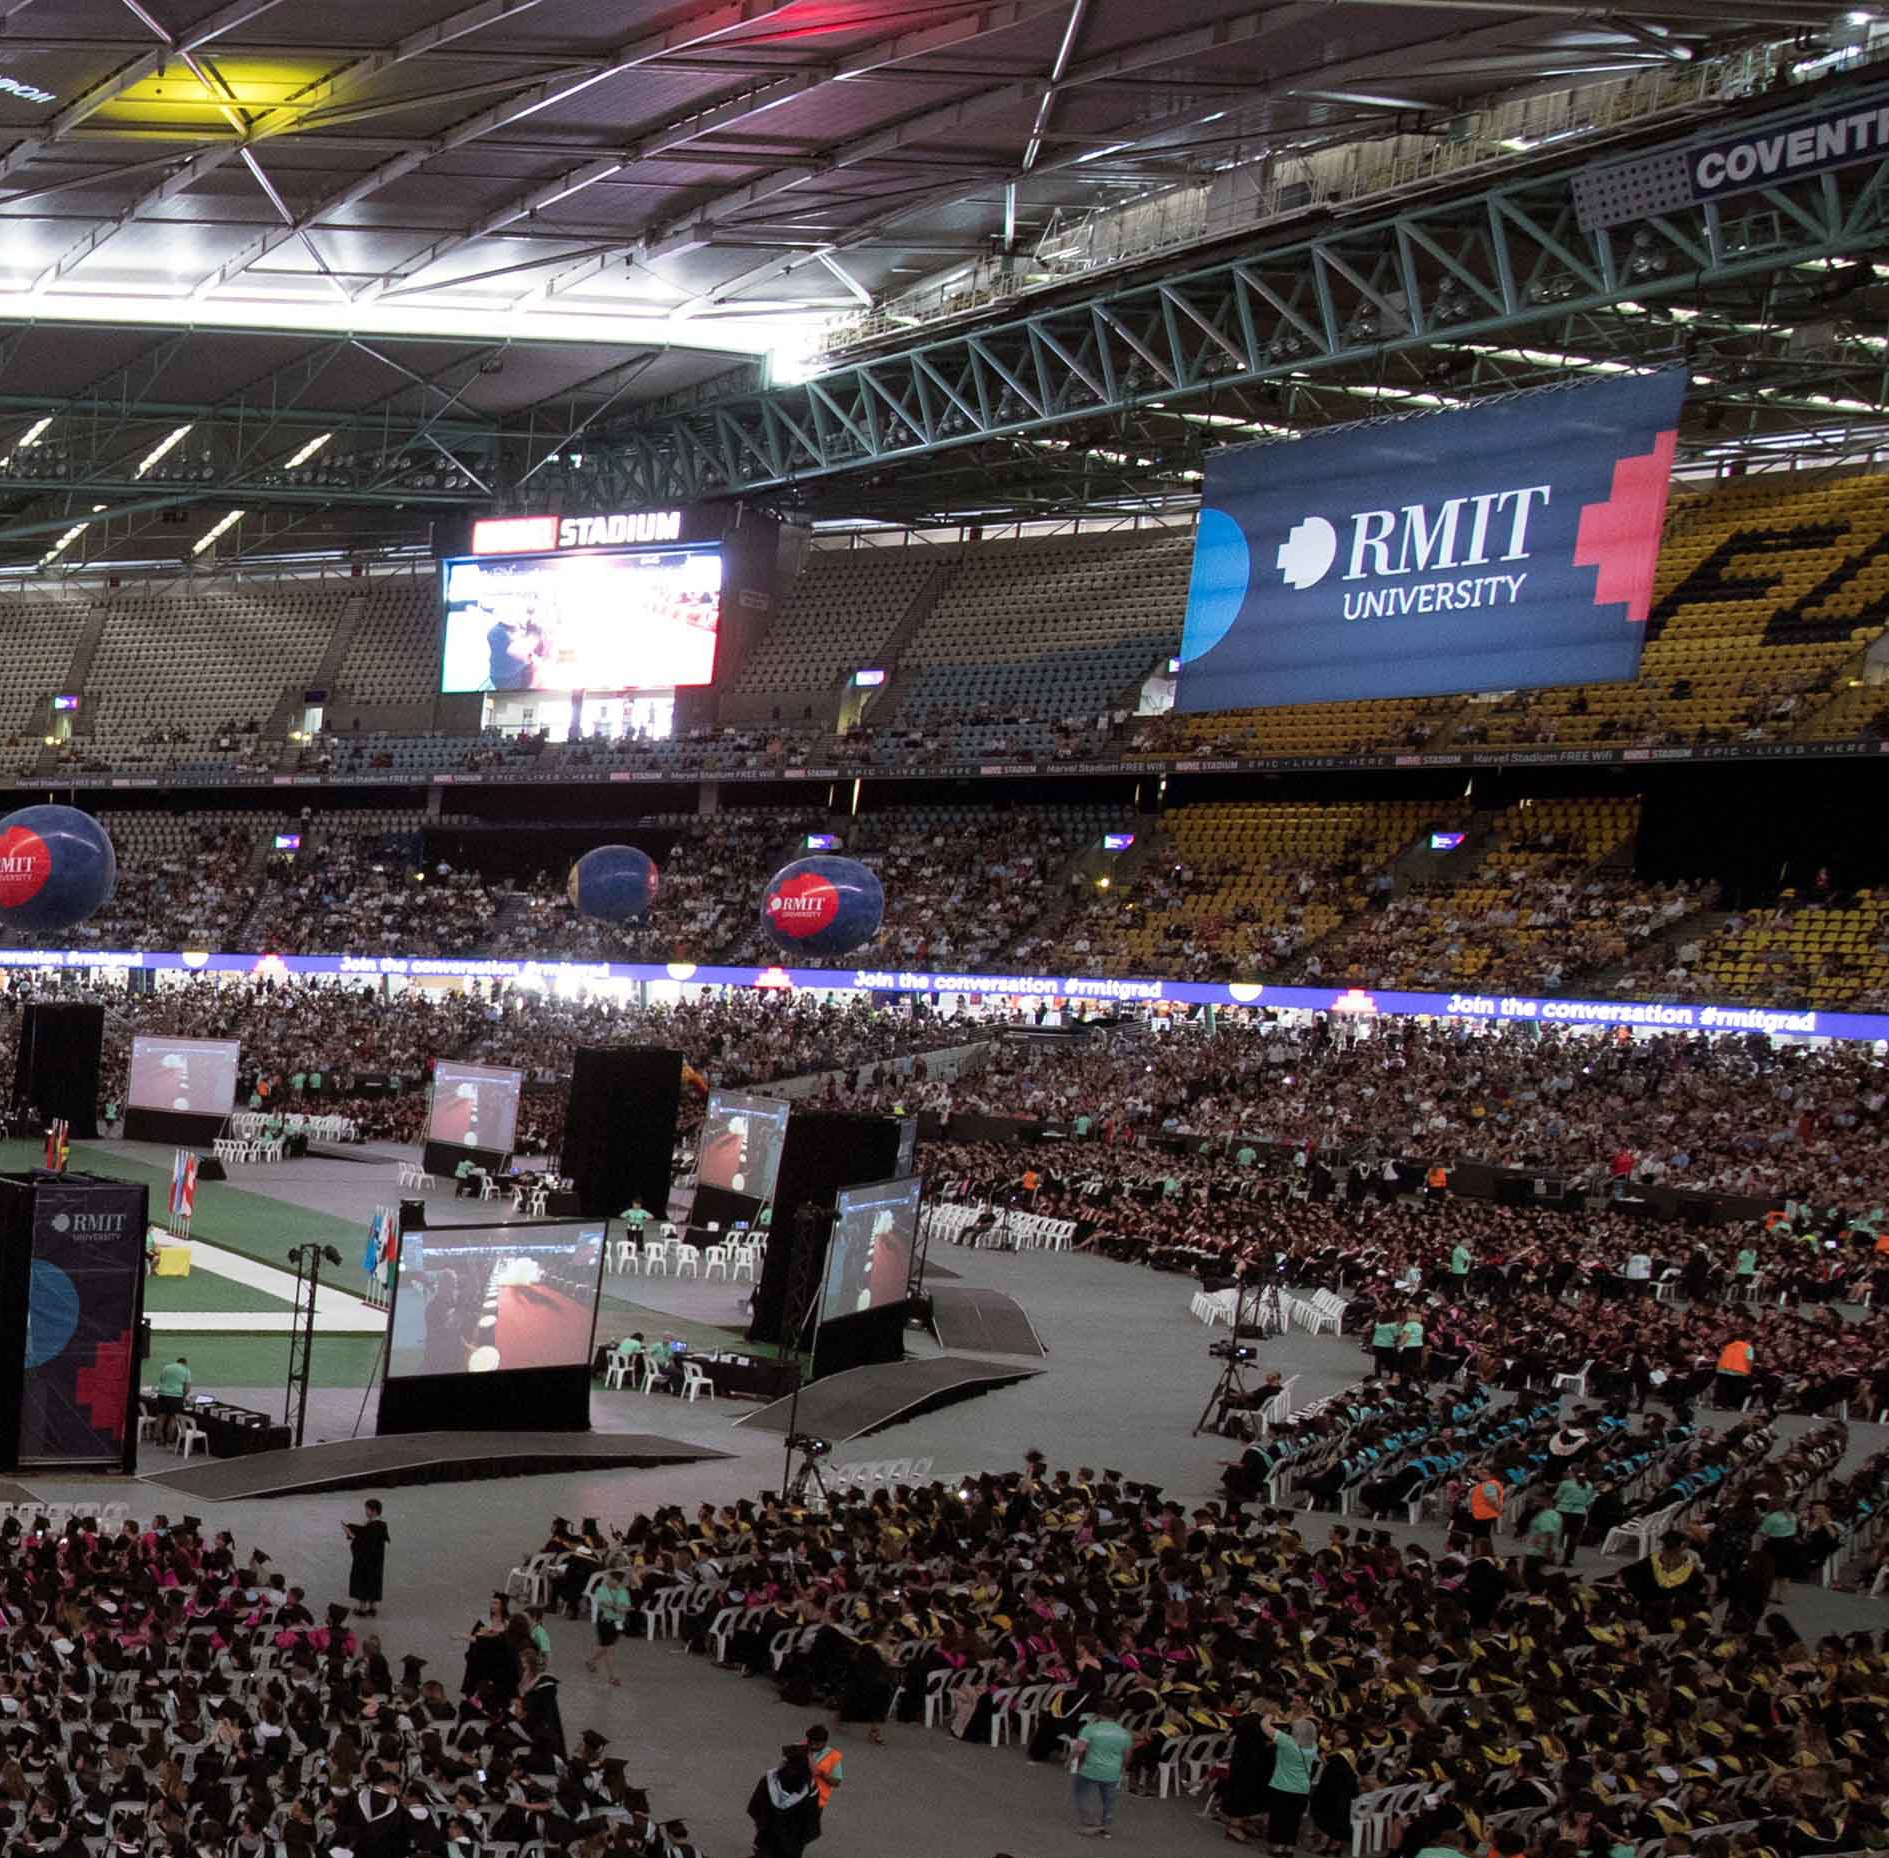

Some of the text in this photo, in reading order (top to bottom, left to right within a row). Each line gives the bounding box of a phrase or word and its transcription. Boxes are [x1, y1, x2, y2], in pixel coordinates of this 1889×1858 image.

[1696, 107, 1889, 189] COVENT
[558, 511, 681, 547] STADIUM
[1342, 485, 1551, 580] RMIT
[1343, 572, 1527, 620] UNIVERSITY
[783, 896, 826, 911] RMIT
[341, 956, 377, 971] Join
[381, 957, 407, 973] the
[854, 971, 1162, 1001] Join the conversation #rmitgrad
[1448, 995, 1815, 1033] Join the conversation #rmitgrad
[73, 1214, 127, 1232] RMIT
